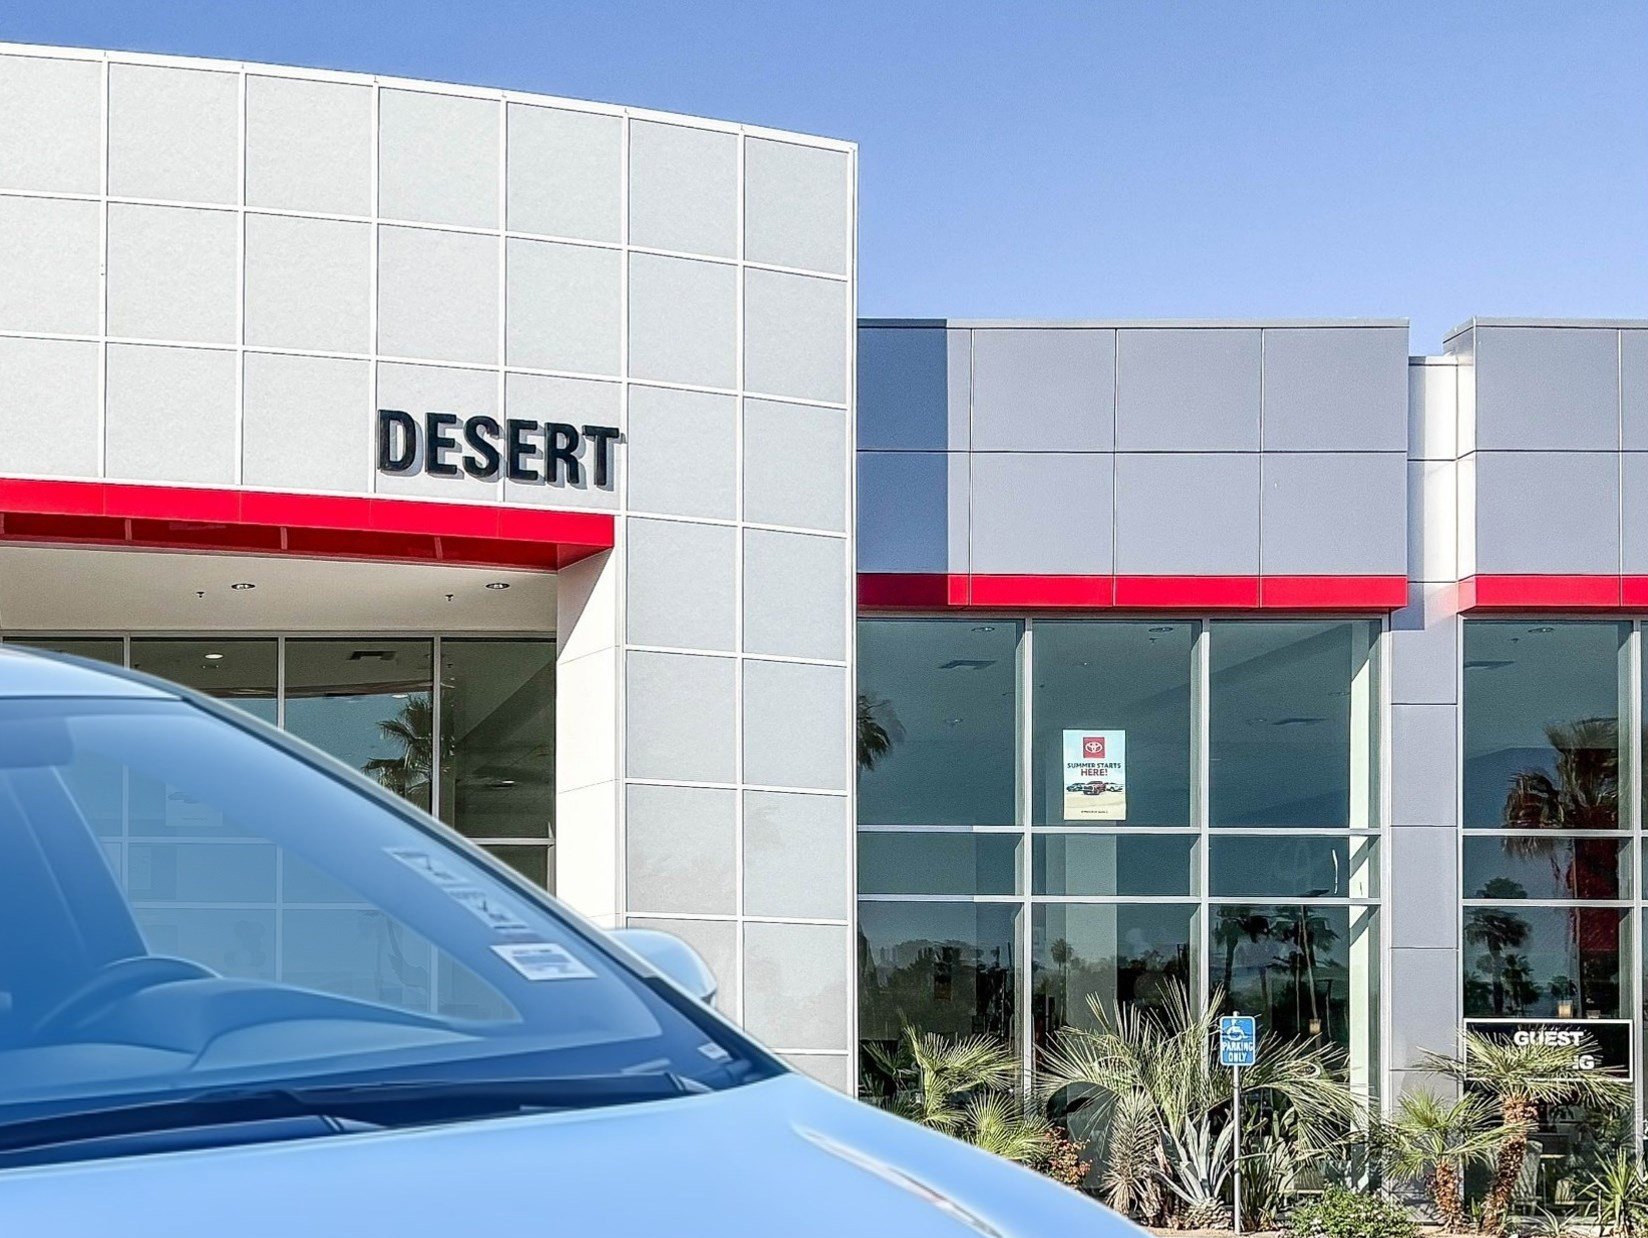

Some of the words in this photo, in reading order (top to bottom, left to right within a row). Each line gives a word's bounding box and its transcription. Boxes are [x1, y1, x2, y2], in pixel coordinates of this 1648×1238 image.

[377, 408, 620, 487] DESERT
[1080, 768, 1108, 776] HERE!
[1513, 1030, 1584, 1047] GUEST
[1222, 1041, 1254, 1052] PARKING
[1228, 1051, 1248, 1062] ONLY
